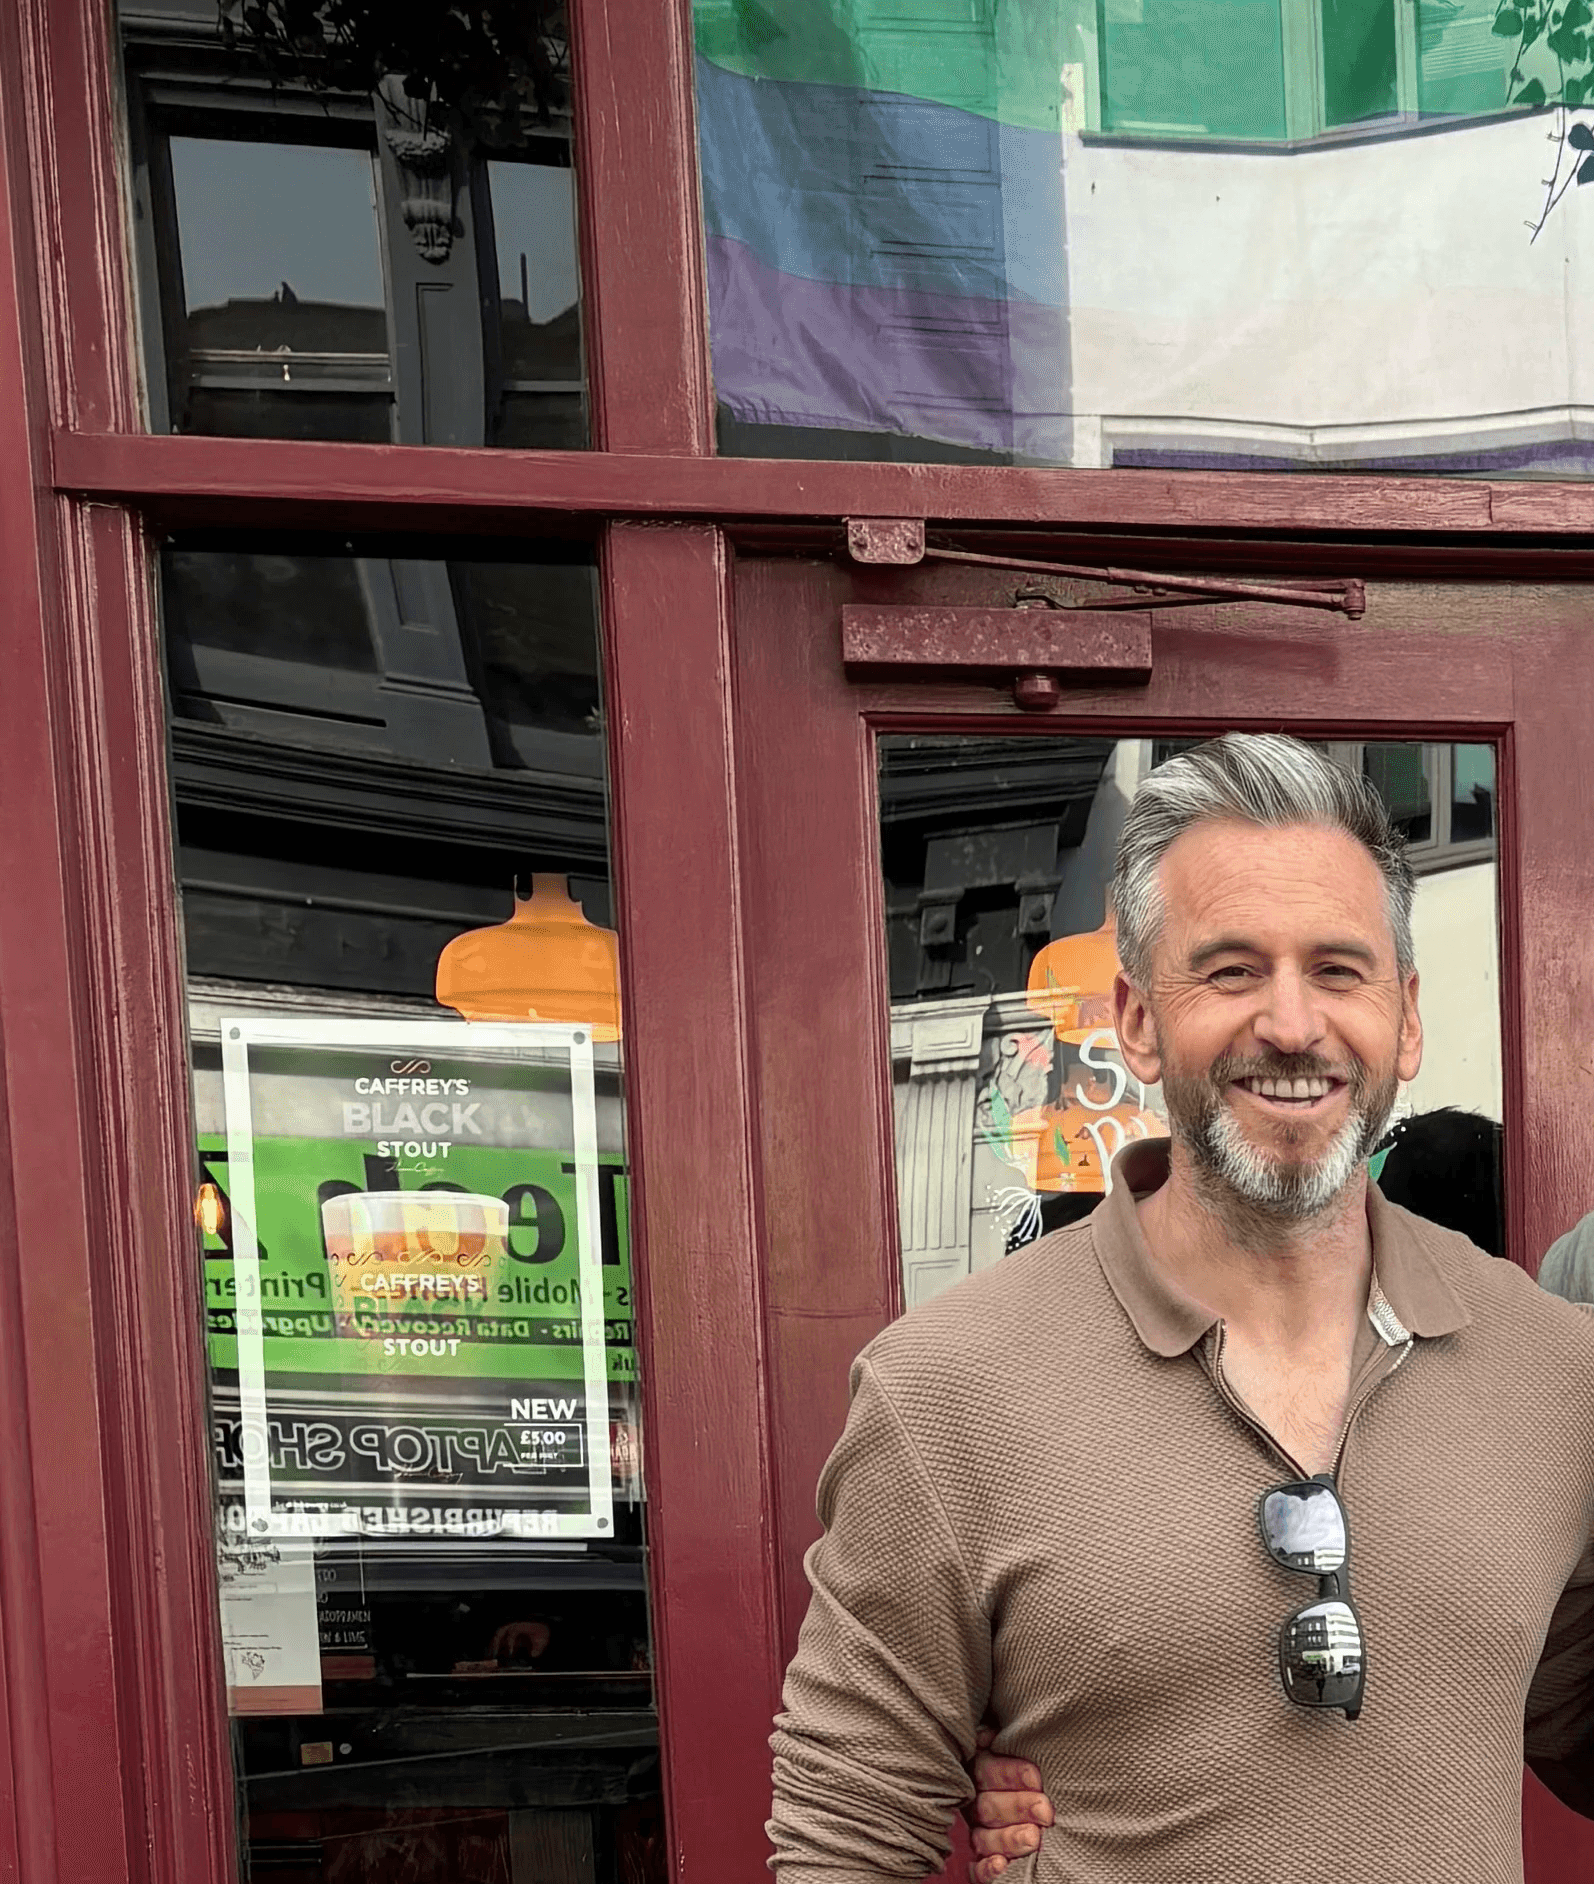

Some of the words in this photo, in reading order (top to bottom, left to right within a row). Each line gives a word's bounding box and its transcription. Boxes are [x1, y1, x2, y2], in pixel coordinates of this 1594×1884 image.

[354, 1077, 470, 1096] CAFFREY'S
[342, 1101, 483, 1136] BLACK
[376, 1140, 452, 1159] STOUT
[382, 1337, 462, 1357] STOUT
[510, 1398, 578, 1420] NEW
